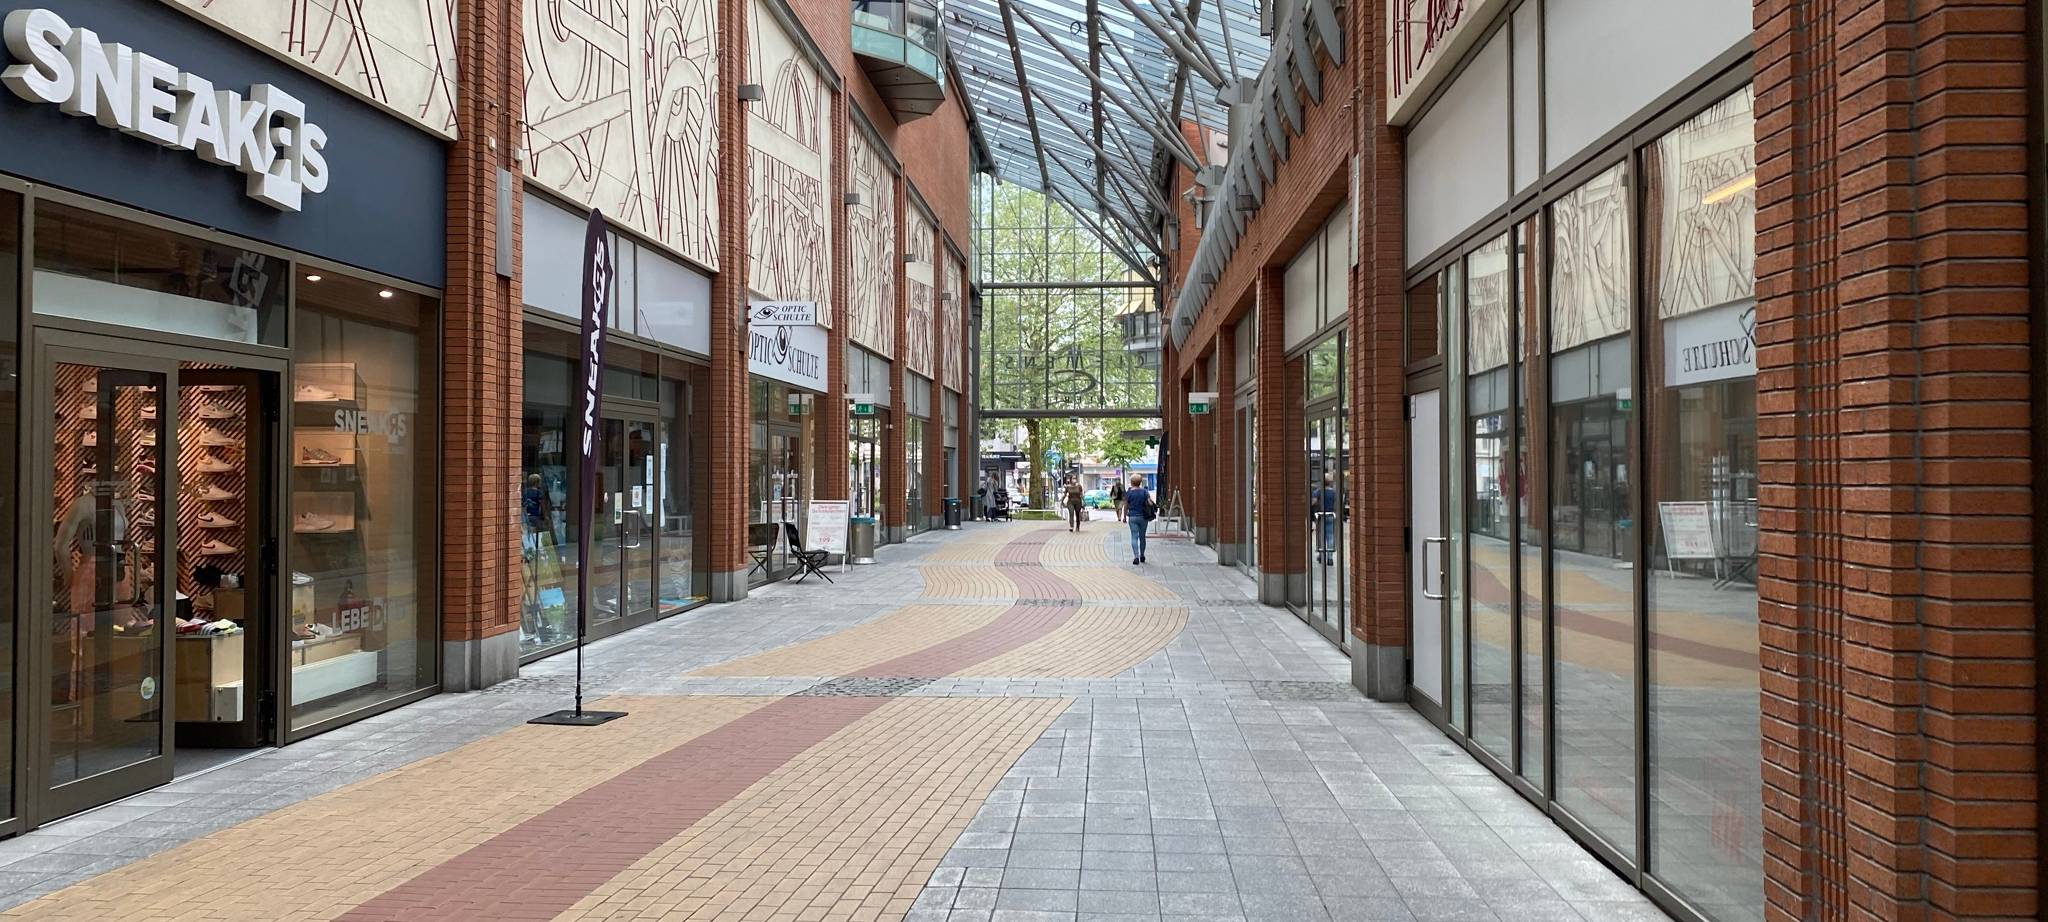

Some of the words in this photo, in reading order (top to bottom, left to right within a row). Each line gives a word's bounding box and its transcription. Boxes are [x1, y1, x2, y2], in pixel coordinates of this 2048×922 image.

[781, 305, 807, 313] OPTIC
[773, 313, 811, 321] SCHULTE
[748, 330, 773, 366] OPTIC
[788, 345, 819, 380] SCHULTE
